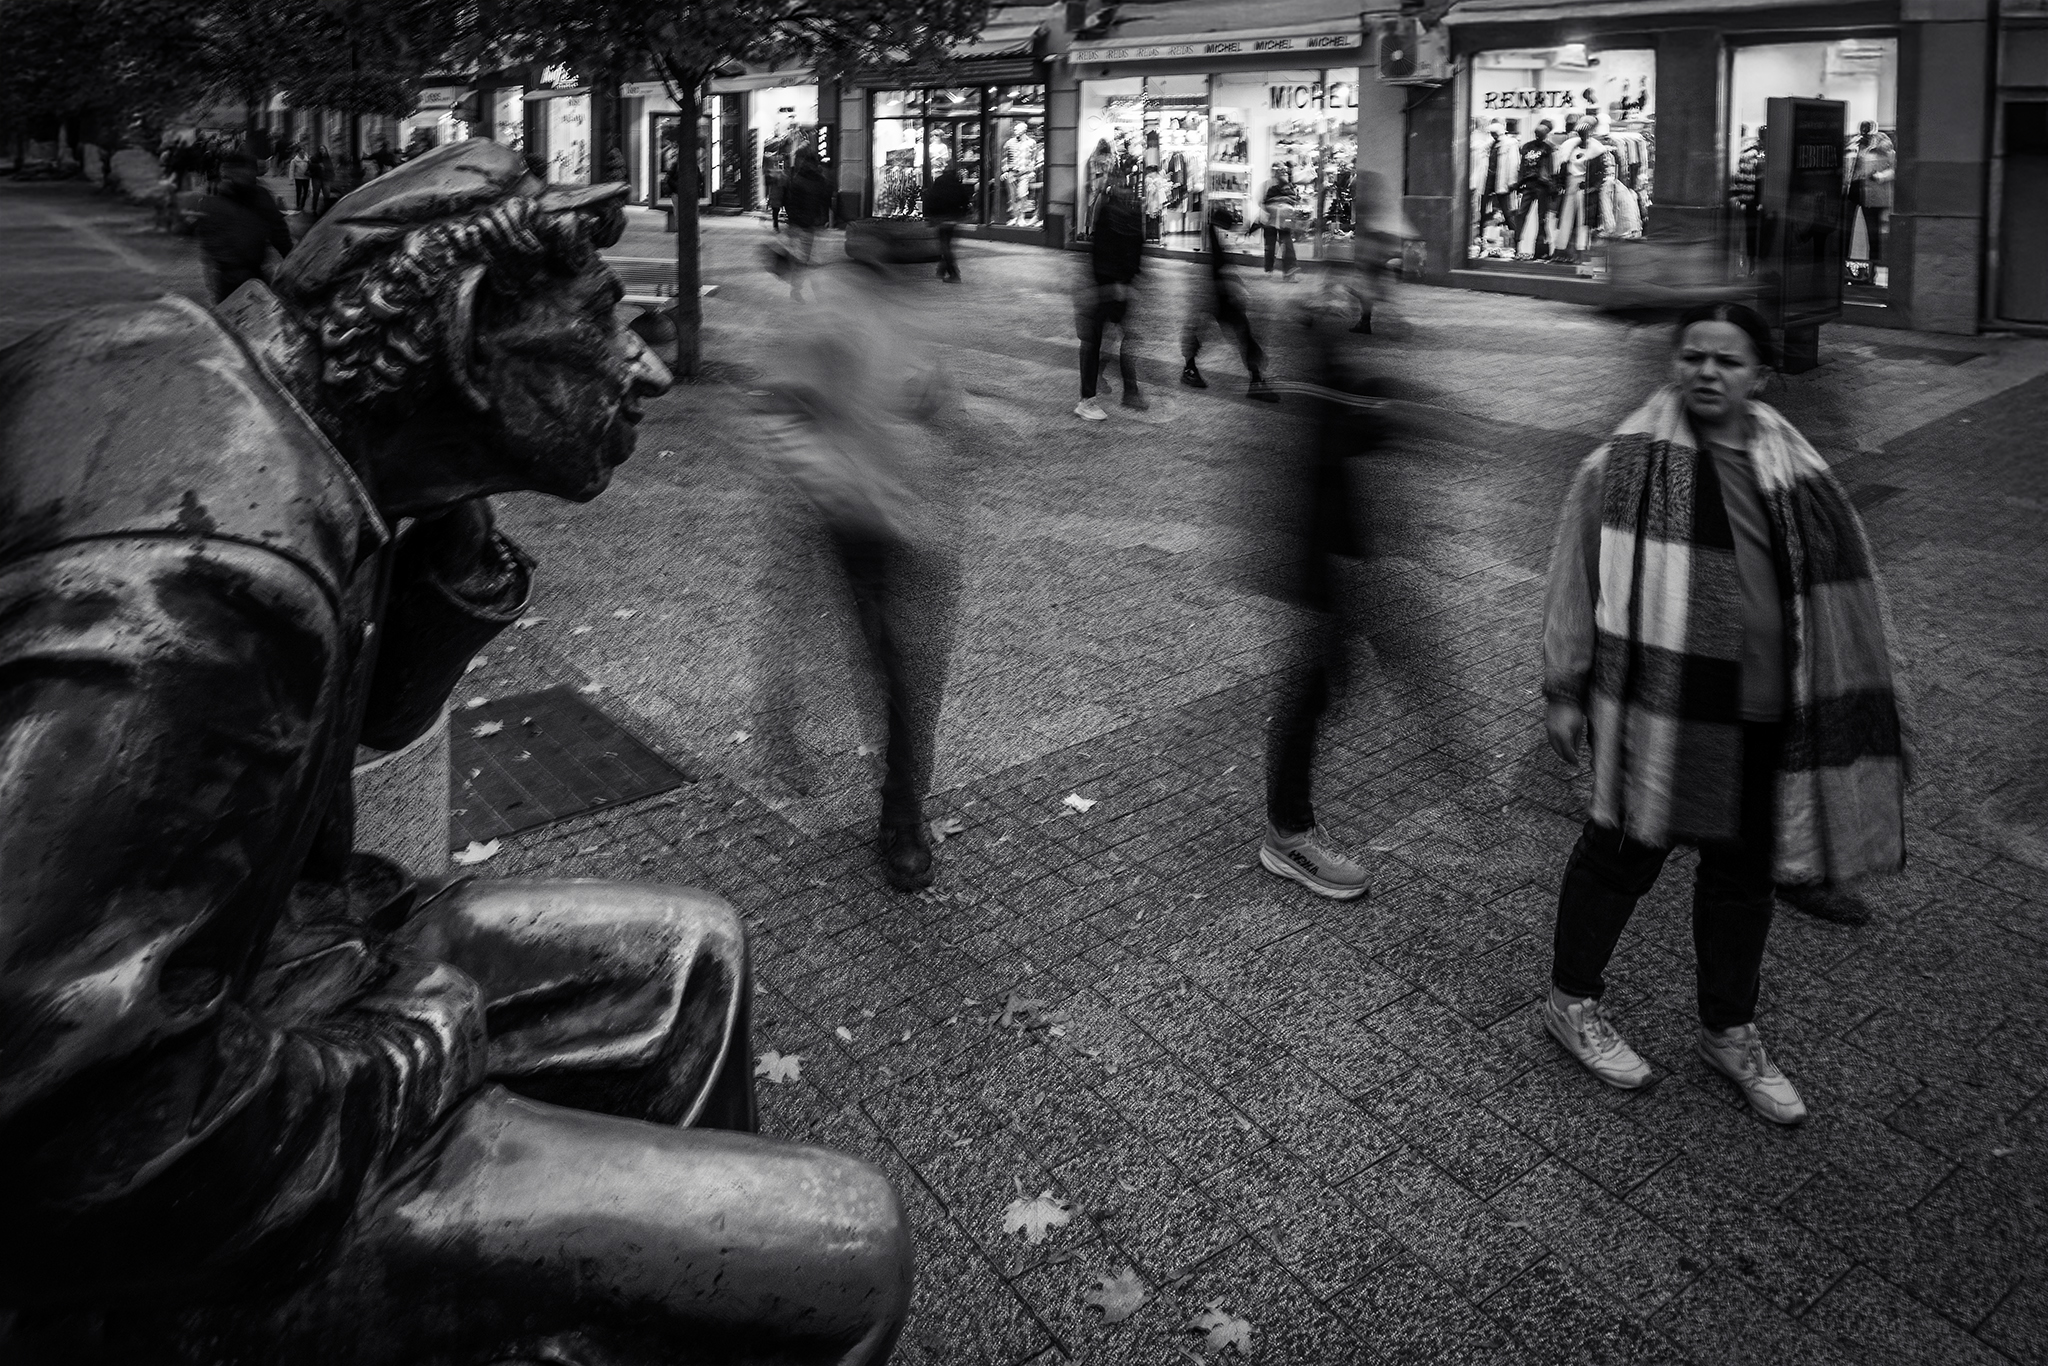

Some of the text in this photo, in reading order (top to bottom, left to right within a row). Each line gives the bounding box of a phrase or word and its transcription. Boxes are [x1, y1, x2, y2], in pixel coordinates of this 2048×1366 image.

[1205, 42, 1243, 53] MICHEL
[1255, 38, 1294, 50] MICHEL
[1308, 35, 1351, 47] MICHEL
[1269, 84, 1358, 109] MICHEL
[1485, 90, 1573, 109] RENATA
